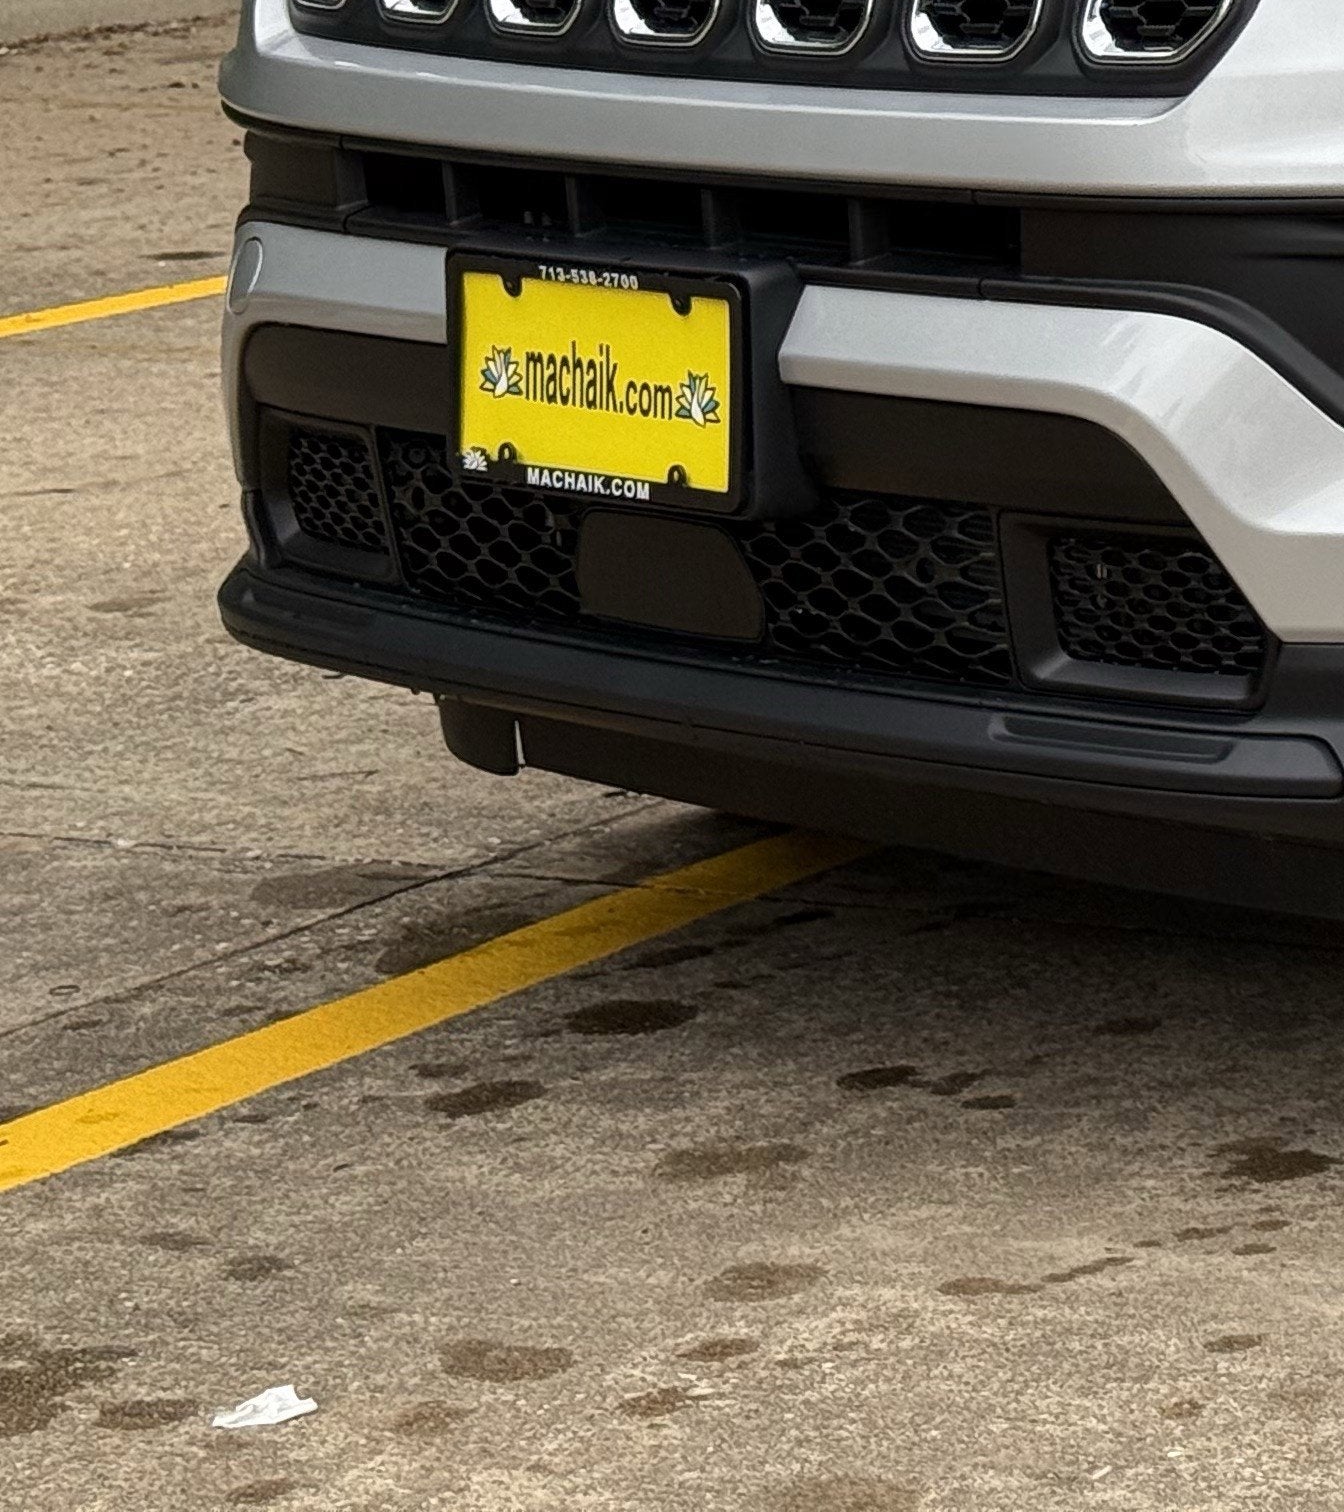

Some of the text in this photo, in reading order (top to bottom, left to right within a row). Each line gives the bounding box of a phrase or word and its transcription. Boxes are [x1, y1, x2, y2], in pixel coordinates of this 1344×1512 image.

[538, 264, 639, 290] 713-538-2700
[525, 339, 674, 420] machaik.com
[526, 467, 650, 501] MACHAIK.COM
